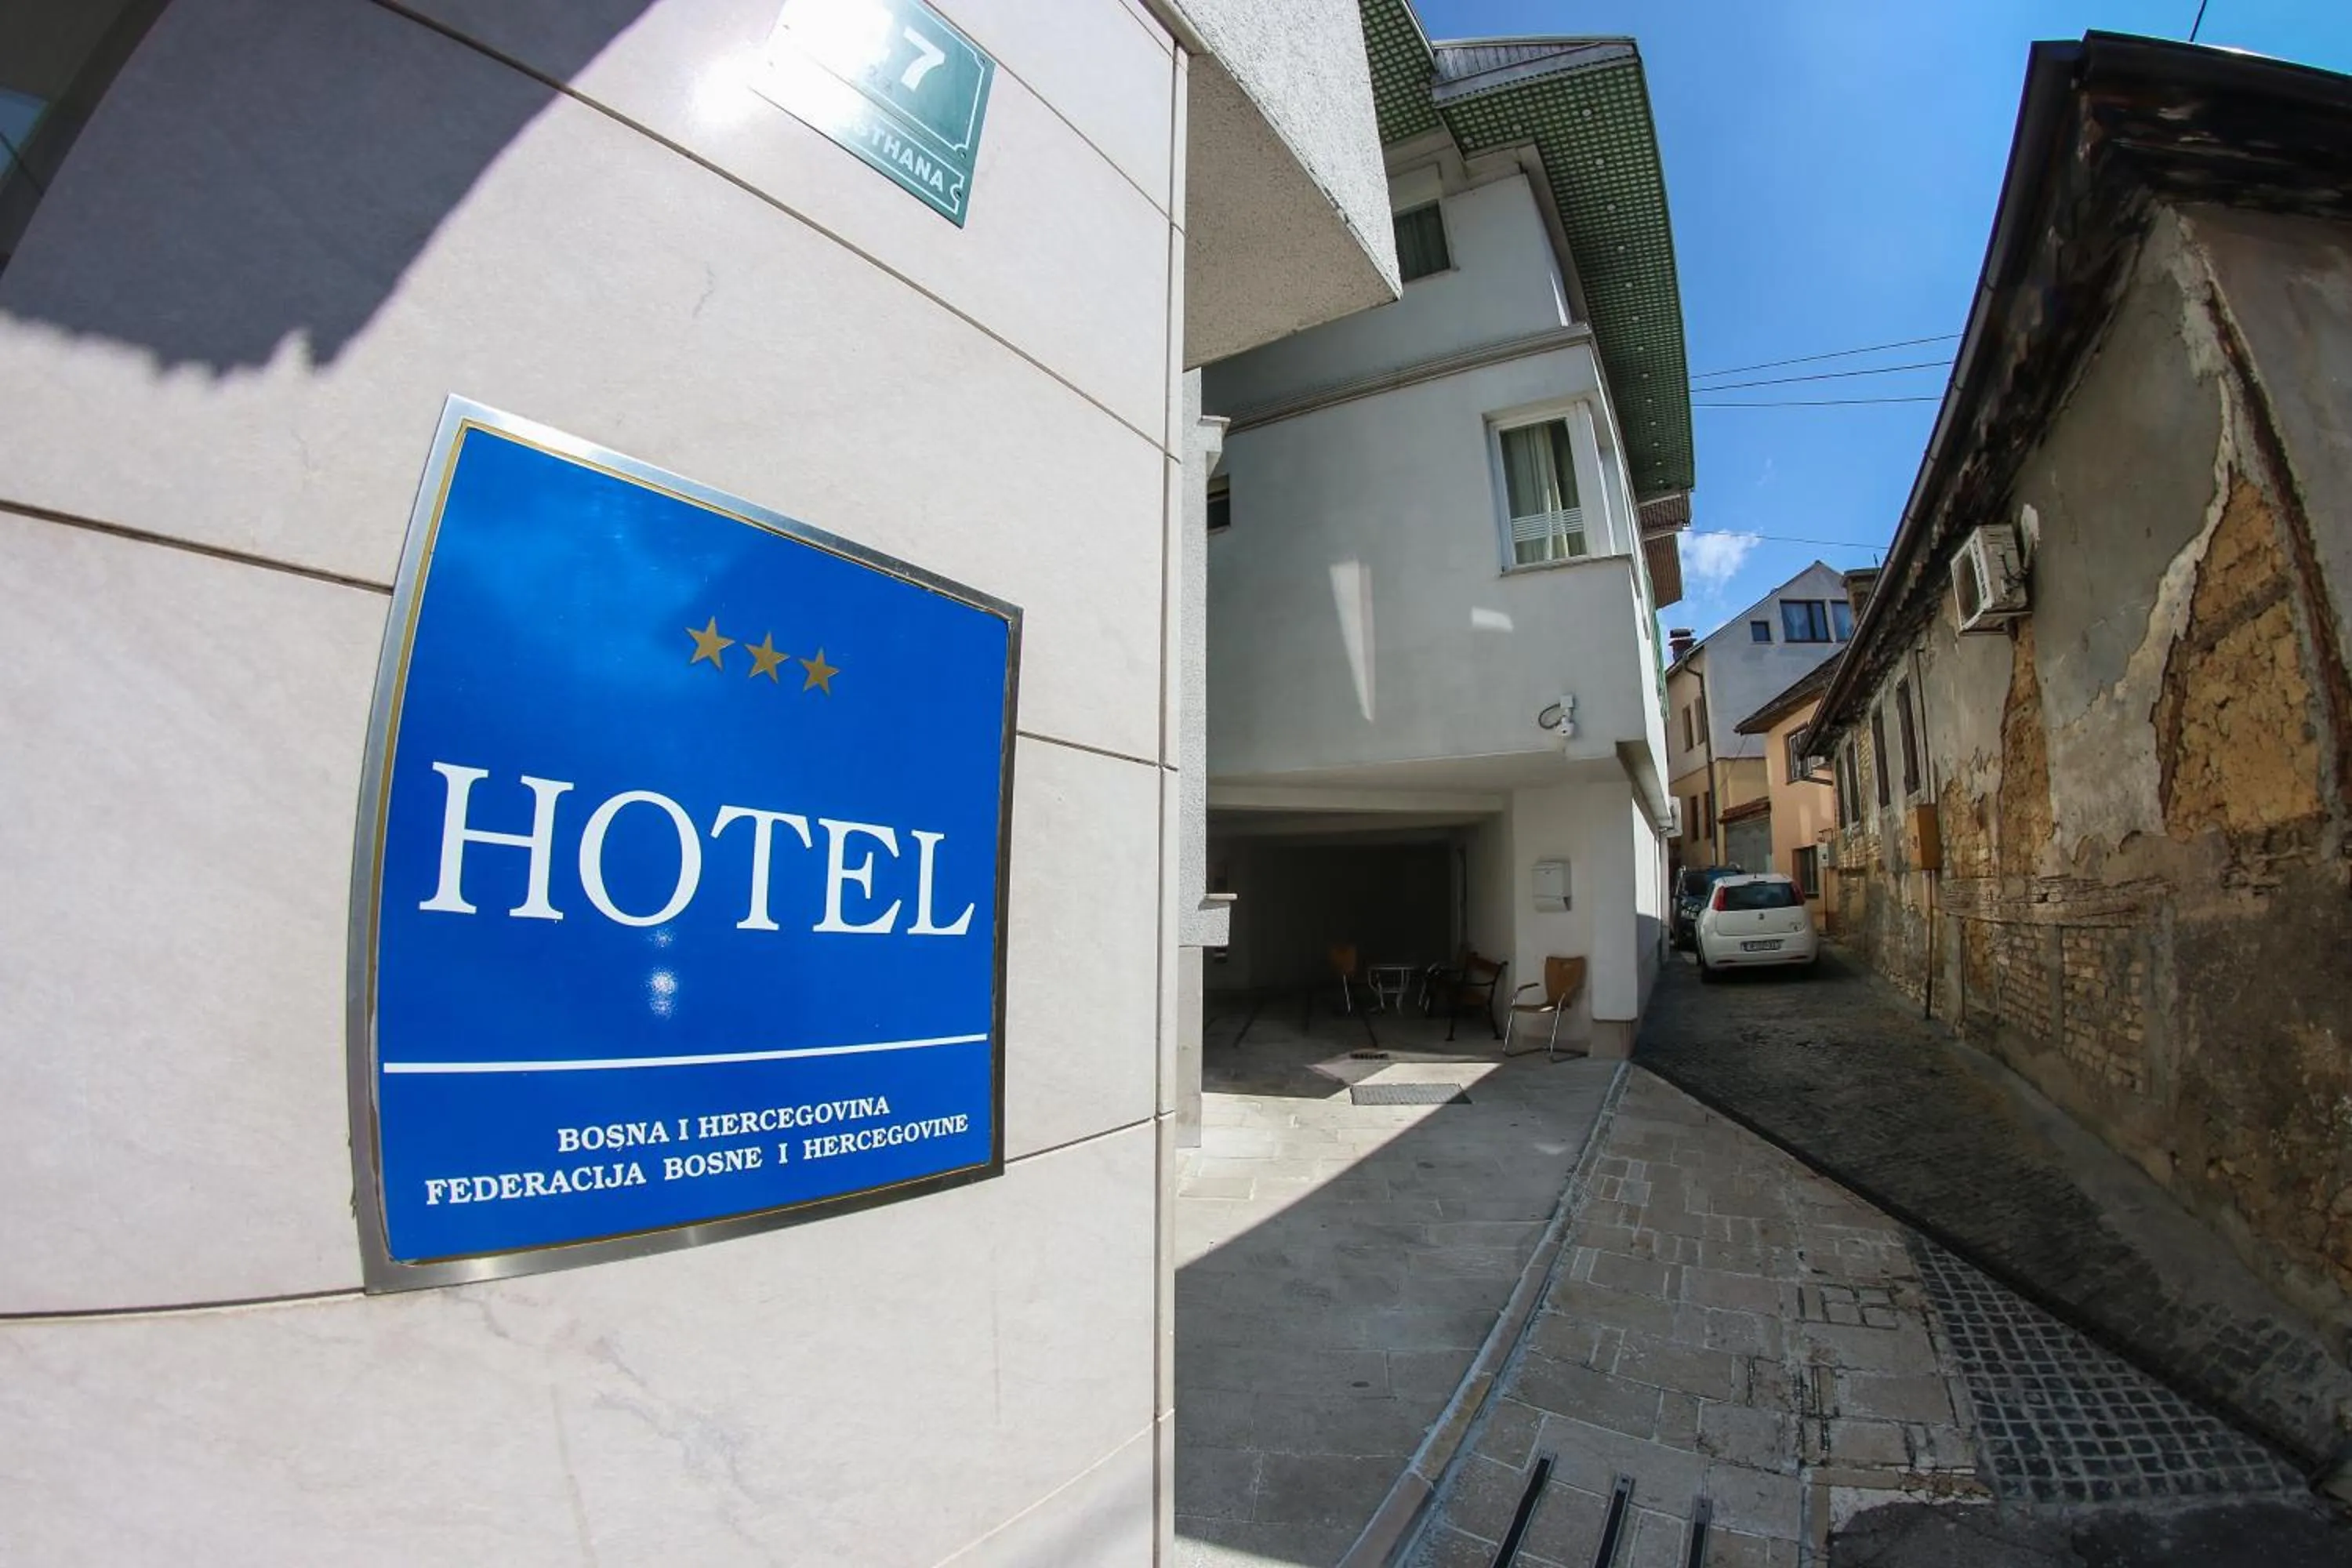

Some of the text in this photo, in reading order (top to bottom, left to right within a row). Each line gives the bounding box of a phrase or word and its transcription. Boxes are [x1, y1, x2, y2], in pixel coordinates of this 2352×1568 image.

[852, 120, 944, 192] STHANA
[419, 761, 975, 935] HOTEL
[424, 1113, 969, 1205] FEDERACIJA BOSNE I HERCEGOVINE
[557, 1096, 891, 1152] BOSNA I HERCEGOVINA
